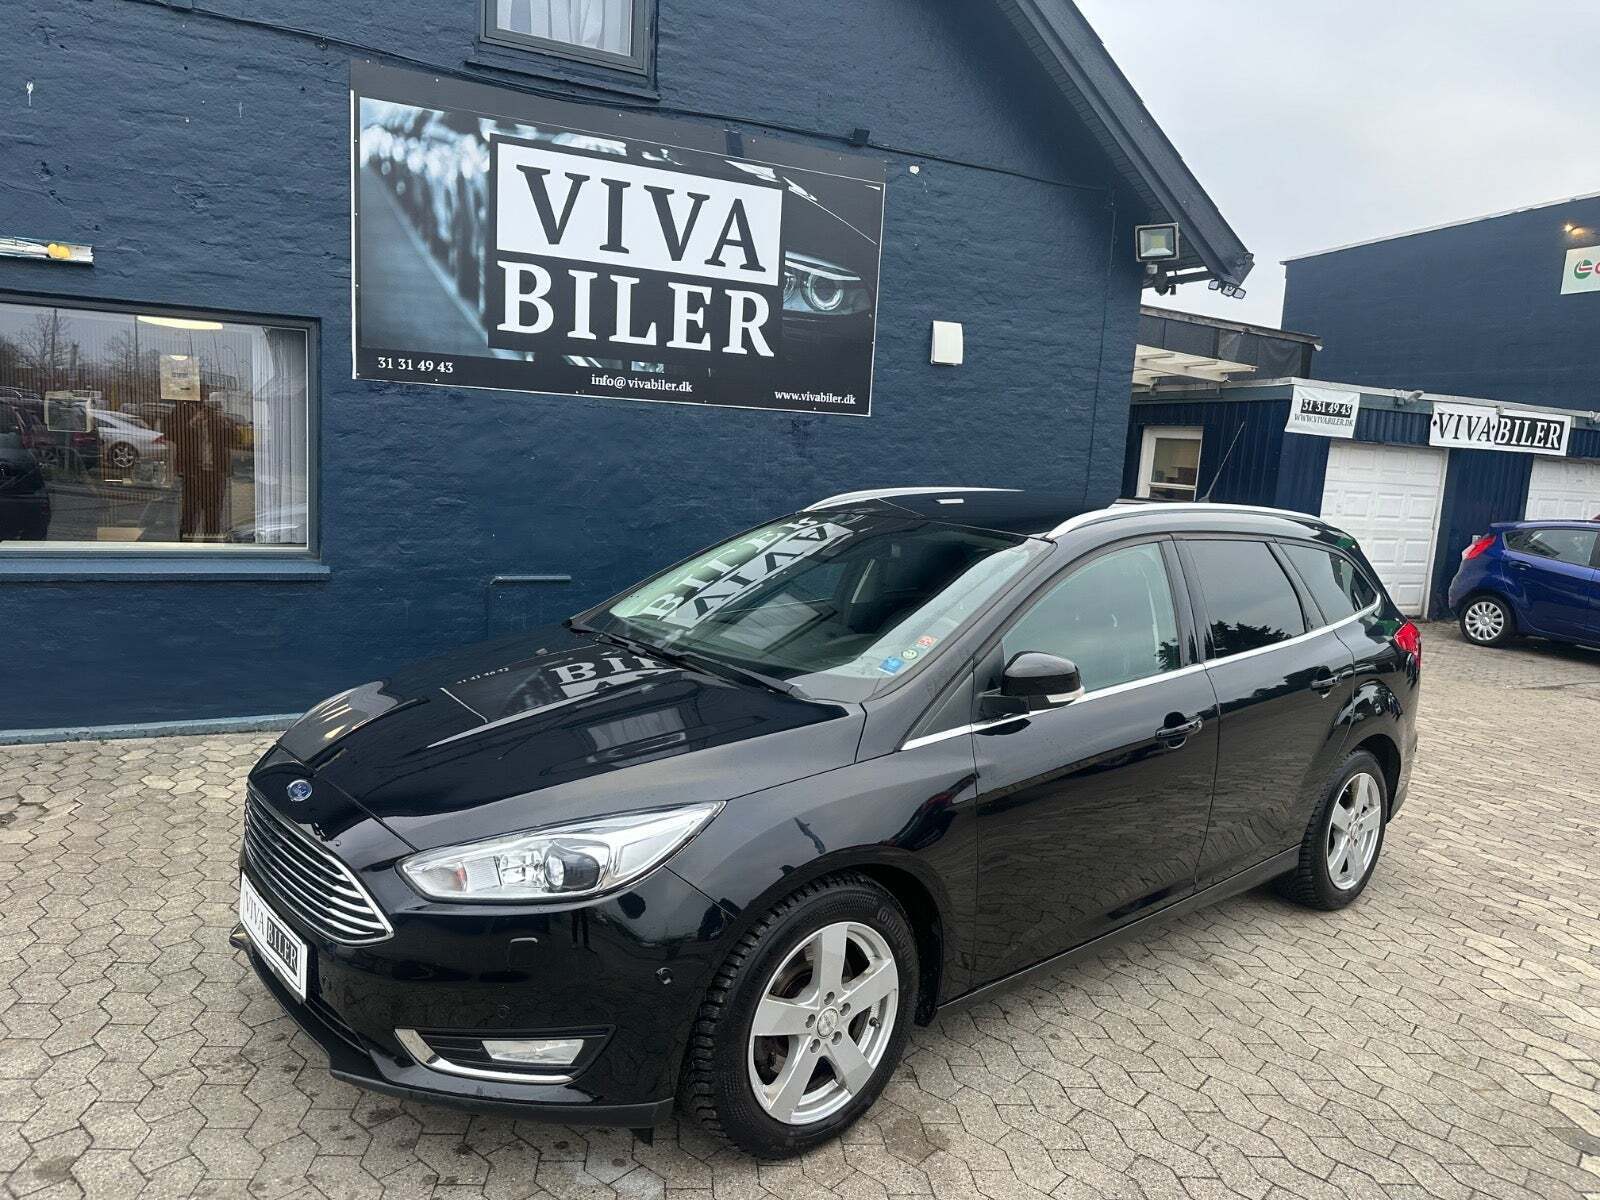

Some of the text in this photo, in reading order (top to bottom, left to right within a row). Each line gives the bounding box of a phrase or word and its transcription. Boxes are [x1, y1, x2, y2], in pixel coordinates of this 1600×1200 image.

[516, 164, 767, 273] VIVA
[496, 260, 775, 358] BILER
[377, 356, 454, 374] 31 31 49 43
[774, 389, 857, 405] www.vivabiler.dk
[1302, 399, 1352, 415] 31 31 49 43
[1437, 412, 1561, 449] VIVA BILER
[245, 890, 298, 971] VIVA BILER
